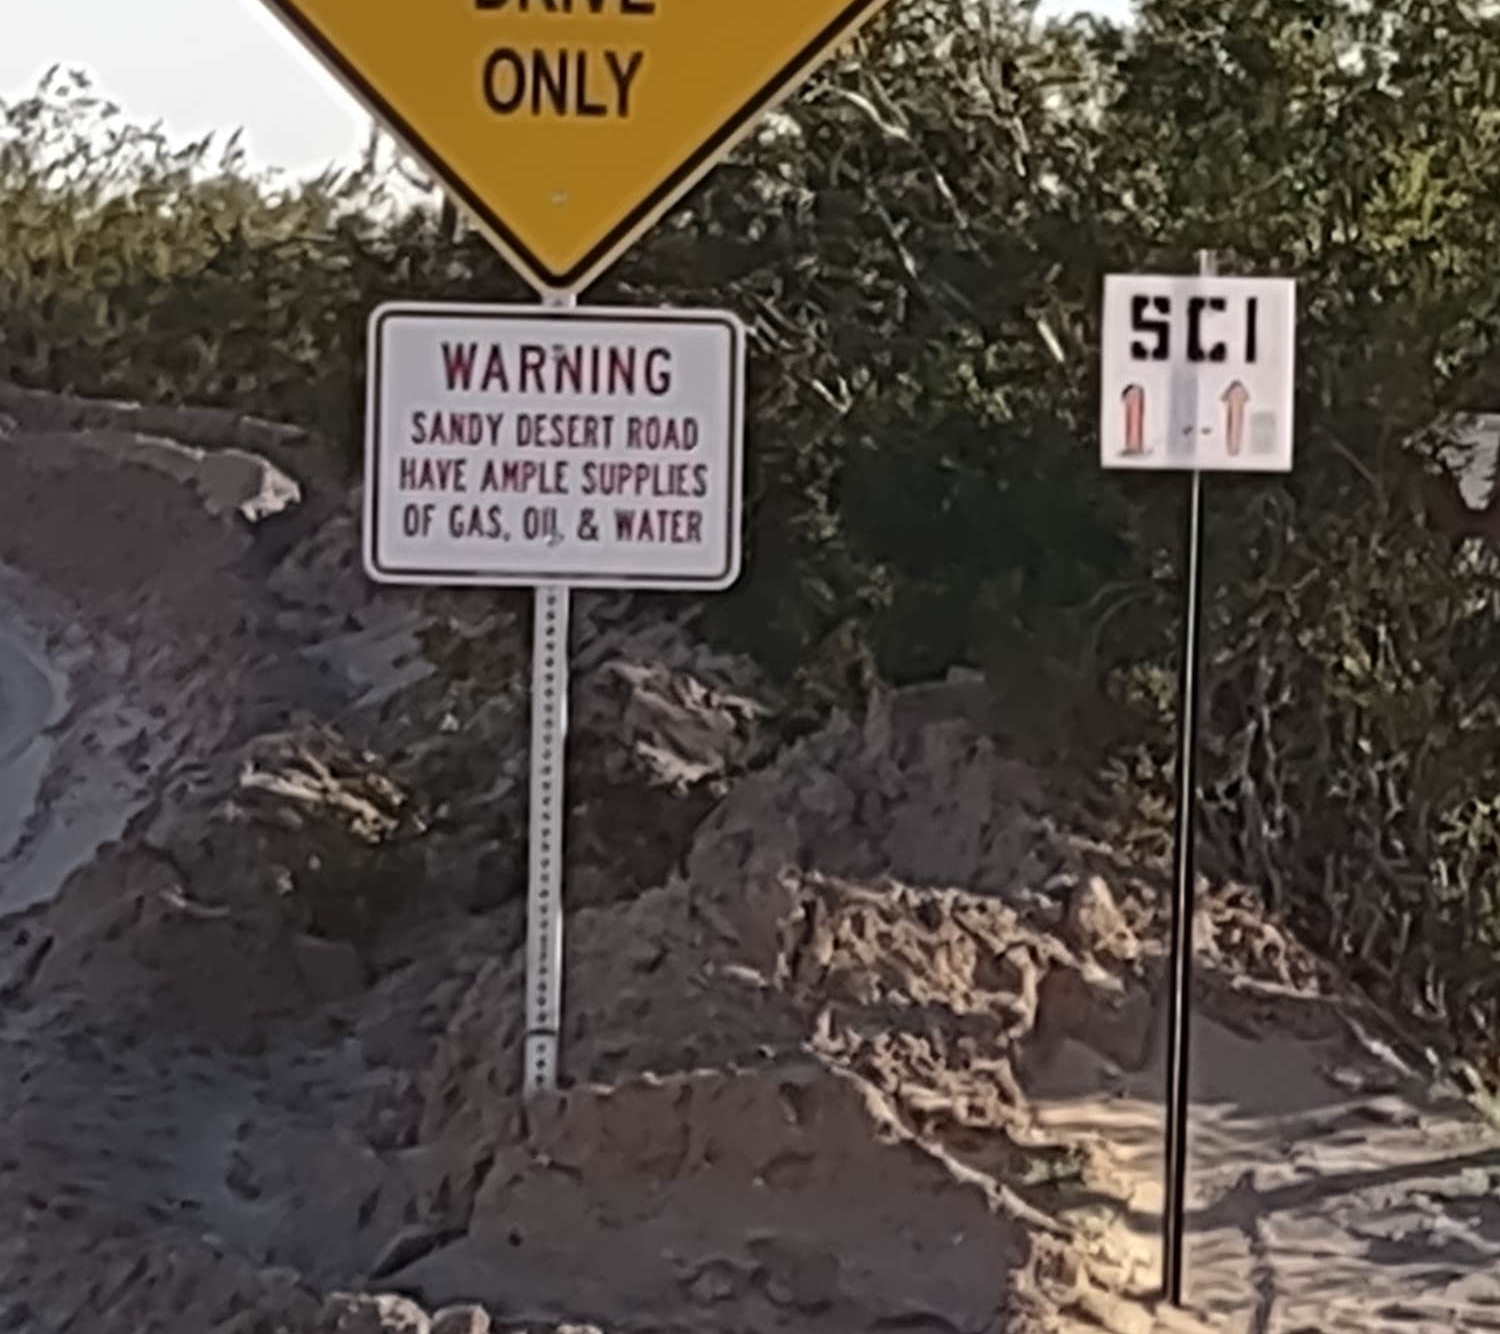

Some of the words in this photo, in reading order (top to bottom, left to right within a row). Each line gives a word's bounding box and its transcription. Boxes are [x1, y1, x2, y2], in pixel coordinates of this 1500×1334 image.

[483, 47, 644, 117] ONLY
[441, 341, 672, 396] WARNING
[411, 411, 504, 447] SANDY
[516, 413, 615, 449] DESERT
[626, 416, 698, 451] ROAD
[400, 457, 467, 493] HAVE
[480, 459, 570, 495] AMPLE
[581, 463, 708, 498] SUPPLIES
[403, 503, 436, 538] OF
[577, 508, 599, 542] &
[614, 508, 704, 544] WATER
